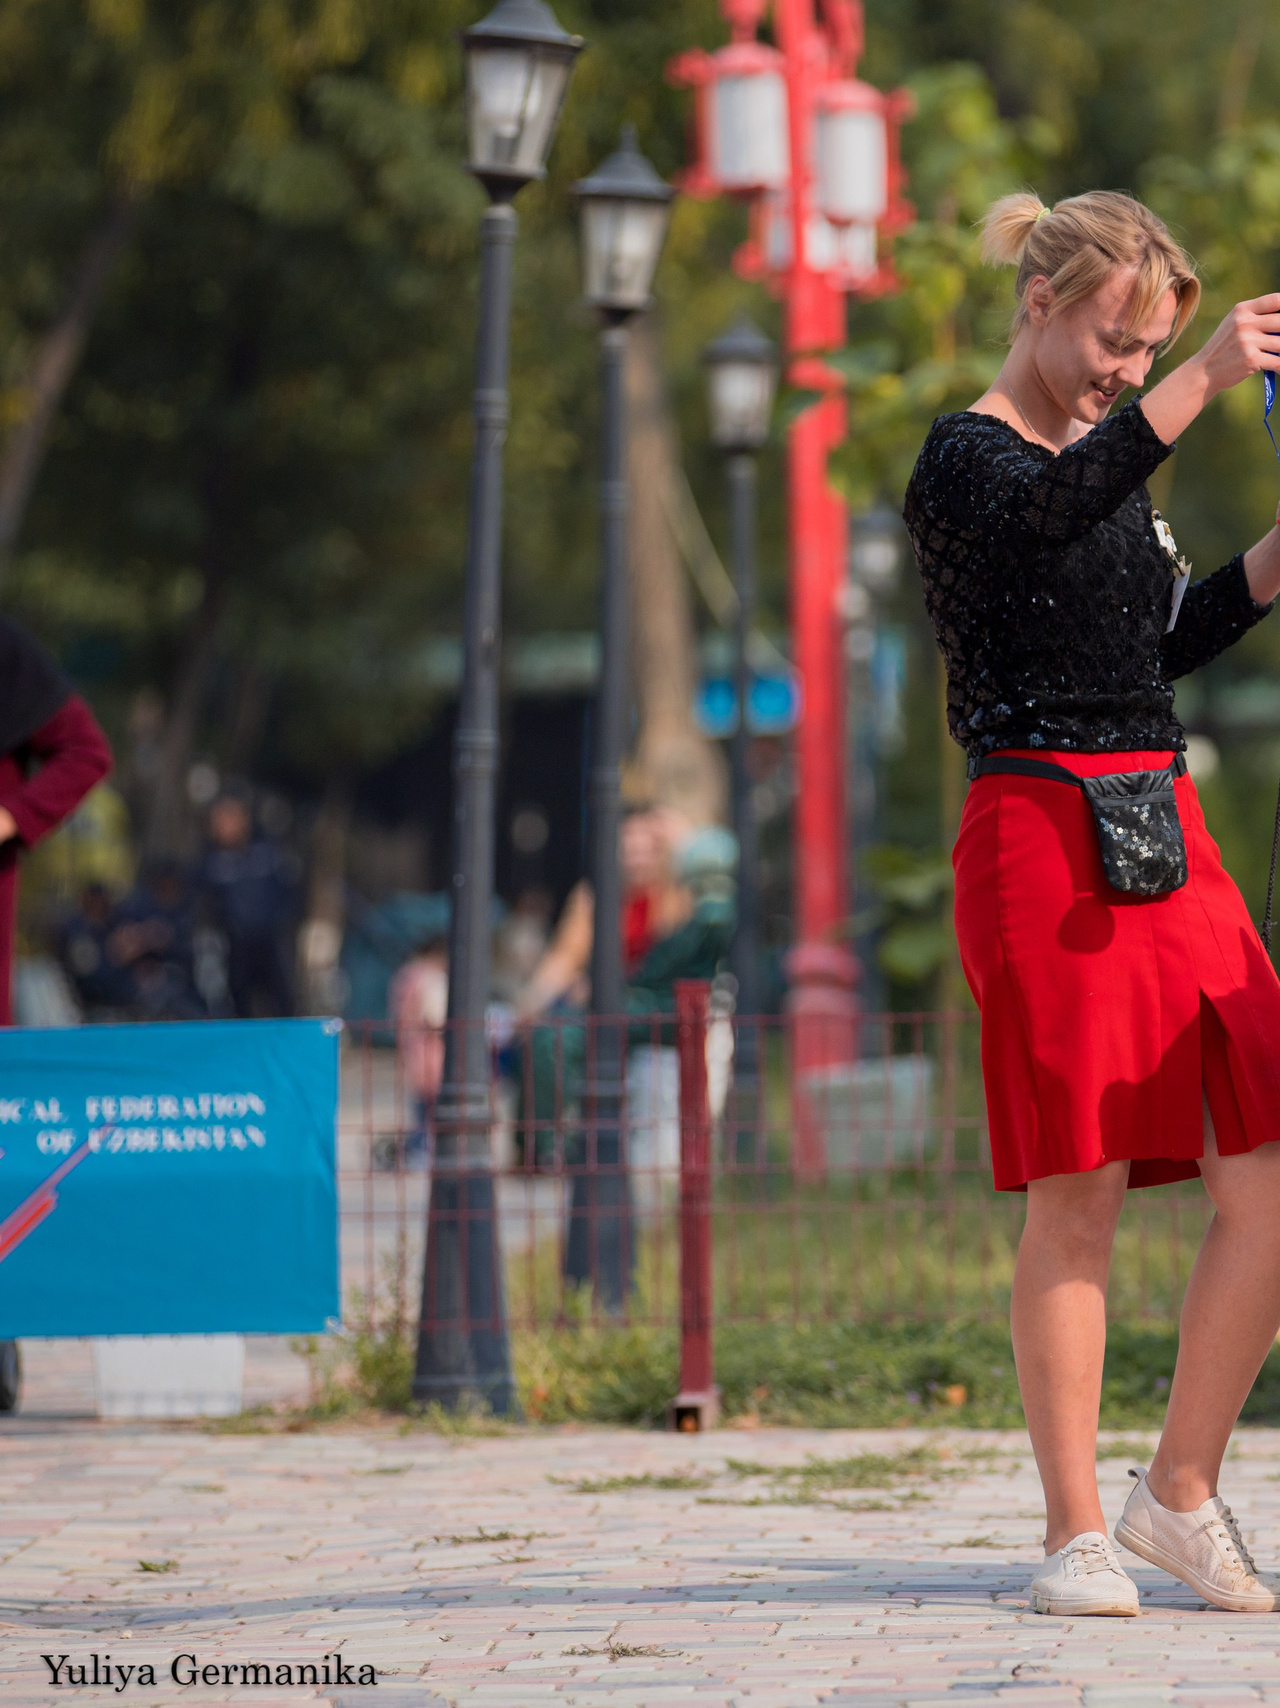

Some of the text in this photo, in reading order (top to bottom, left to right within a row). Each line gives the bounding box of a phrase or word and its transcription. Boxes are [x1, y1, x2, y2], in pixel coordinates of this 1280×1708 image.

[0, 1092, 266, 1124] ICAL FEDERATION
[36, 1124, 266, 1155] OF UZBEKISTAN
